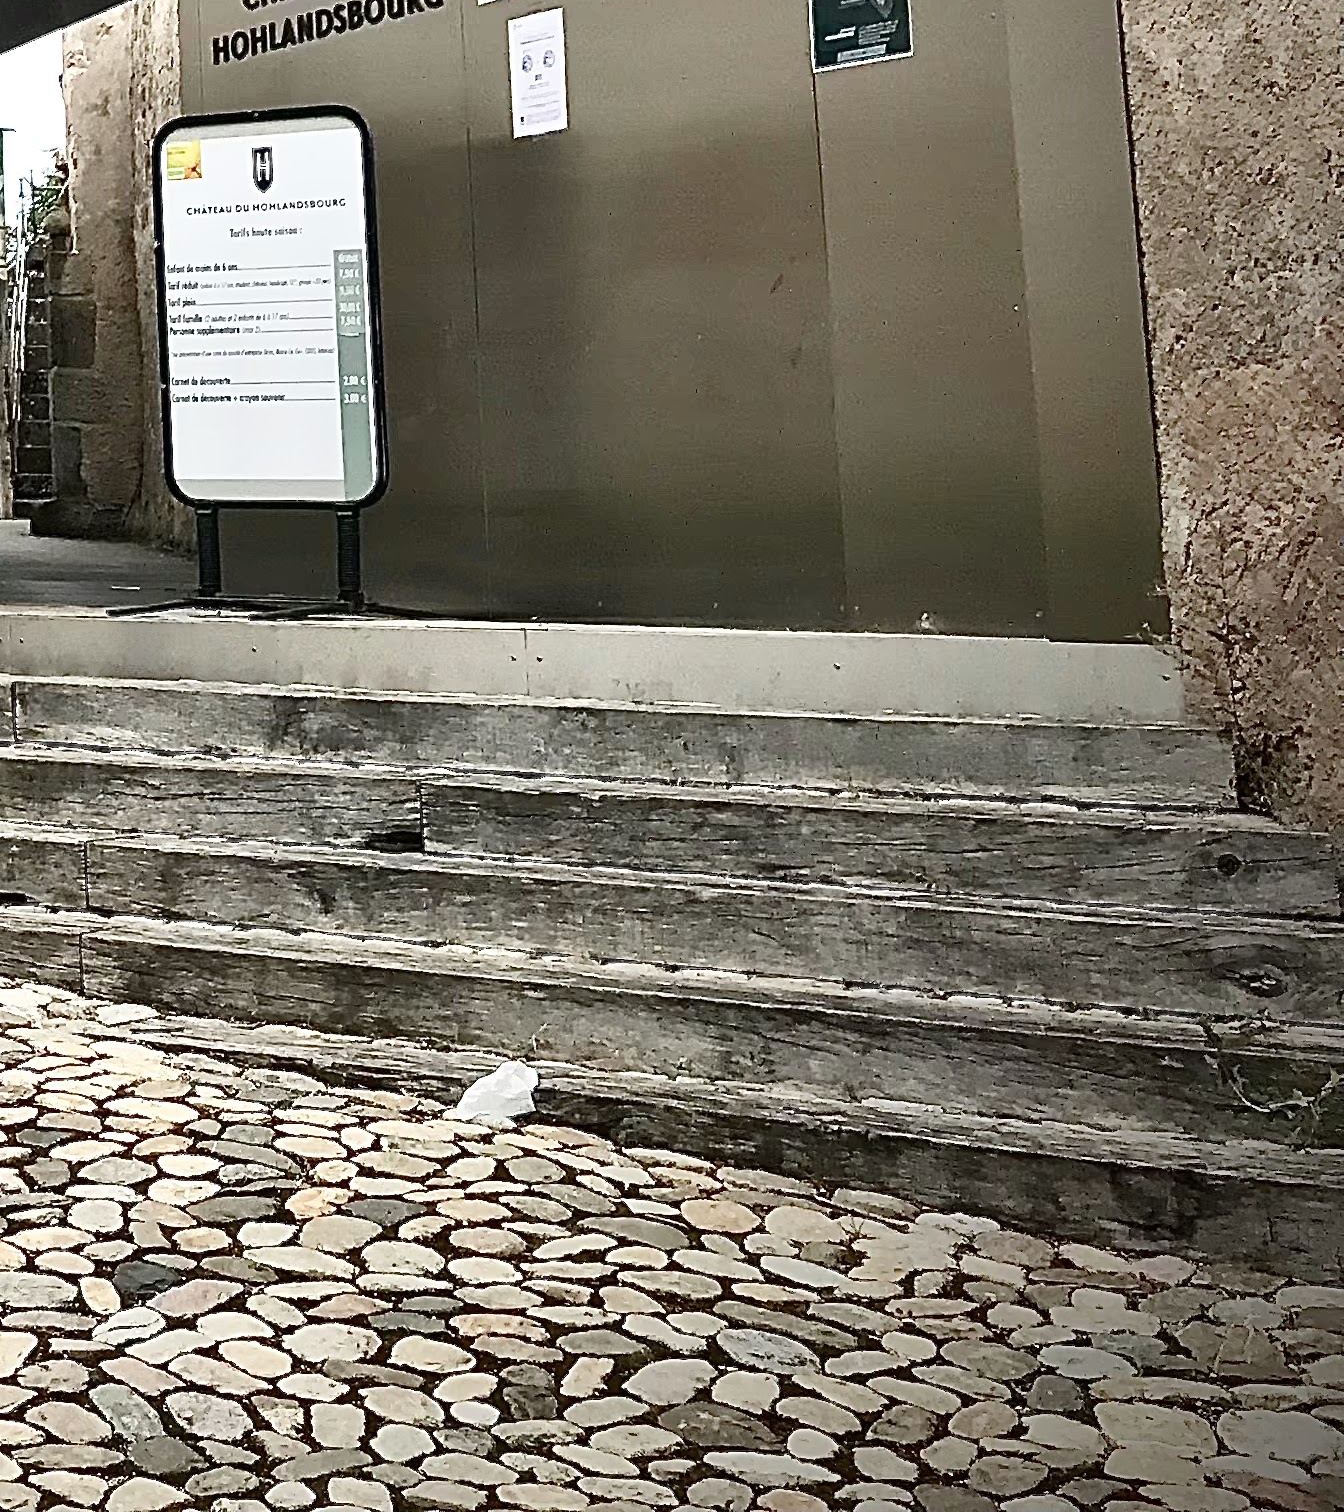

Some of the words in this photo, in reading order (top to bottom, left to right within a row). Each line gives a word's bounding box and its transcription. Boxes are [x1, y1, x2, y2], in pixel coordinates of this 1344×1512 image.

[186, 203, 232, 216] CHÂTEAU
[235, 204, 250, 213] DU
[252, 198, 347, 212] HOHLANDSBOURG
[229, 228, 250, 238] Tarifs
[252, 227, 272, 237] haute
